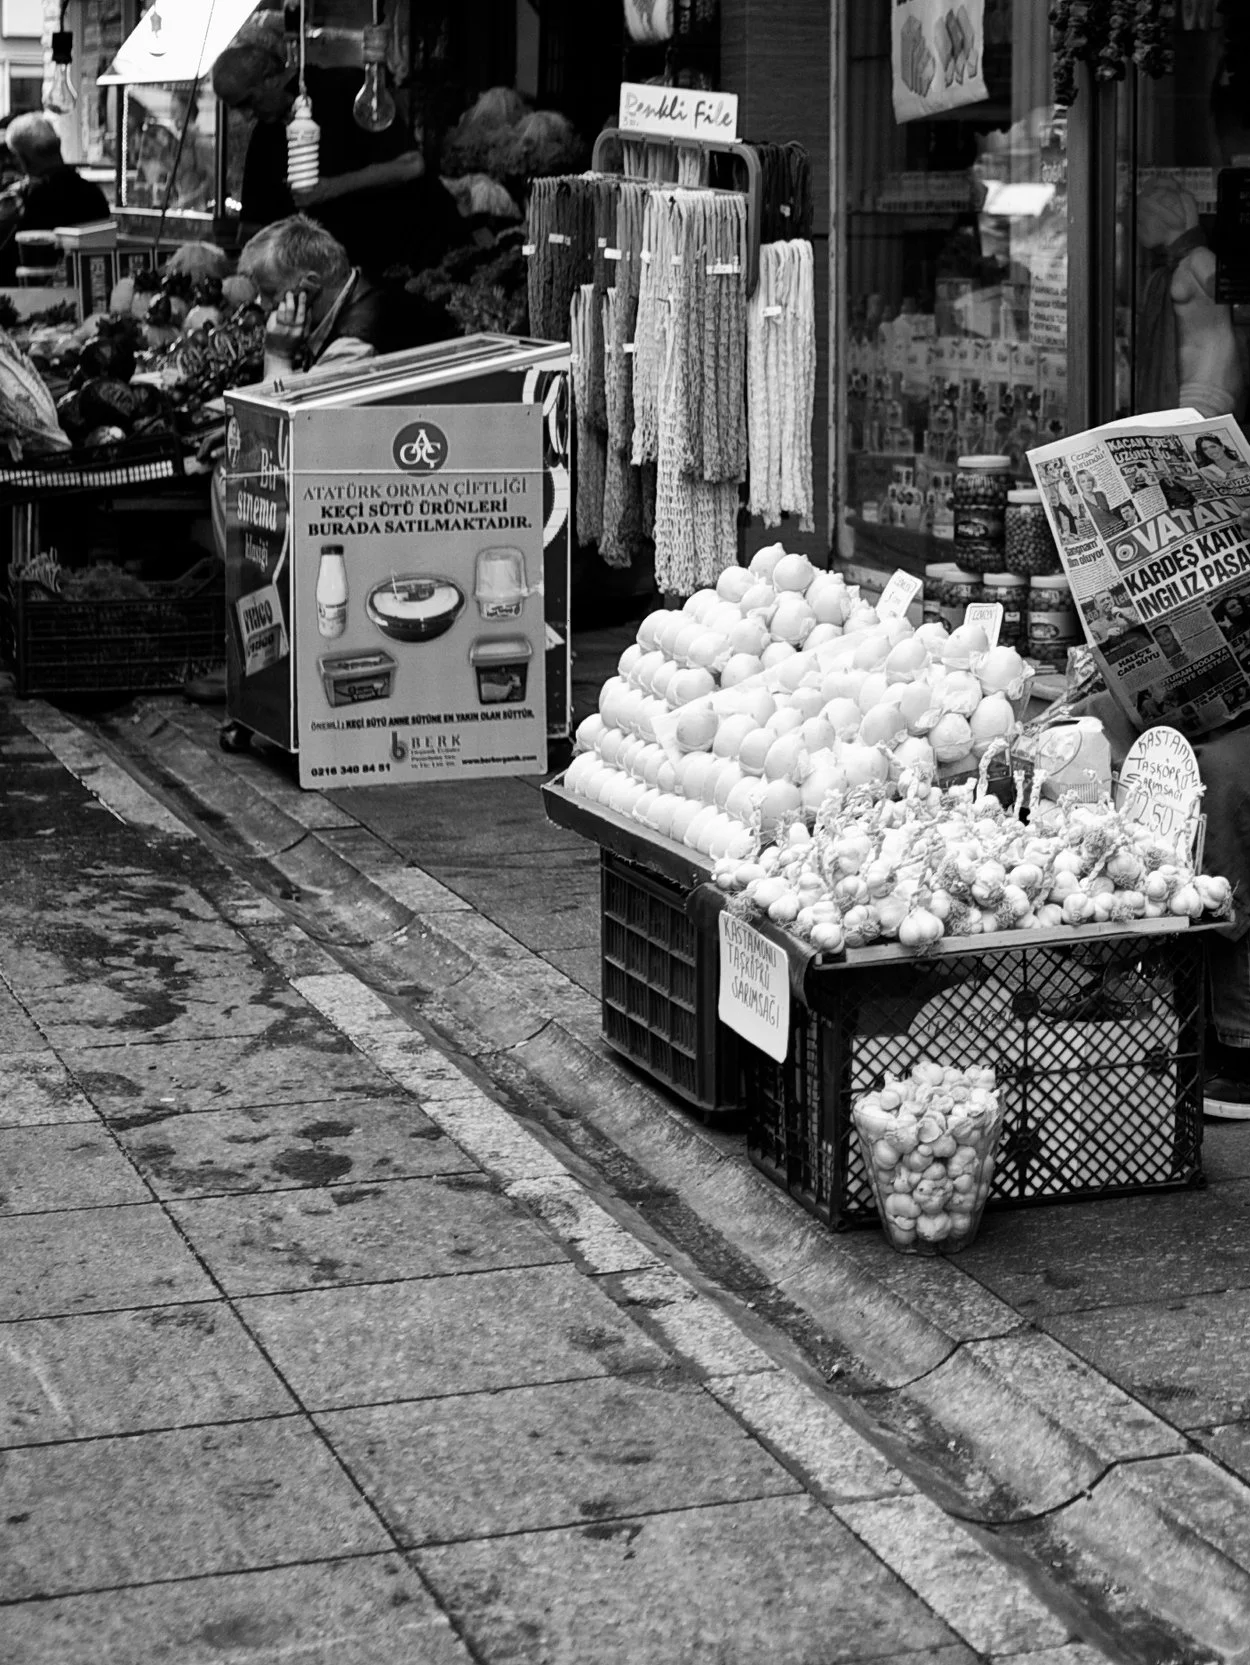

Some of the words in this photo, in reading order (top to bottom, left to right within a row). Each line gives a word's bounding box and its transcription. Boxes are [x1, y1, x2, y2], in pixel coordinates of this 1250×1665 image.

[624, 91, 688, 121] Renkli
[694, 99, 733, 129] File
[303, 482, 381, 500] ATATÜRK
[386, 482, 449, 498] ORMAN
[454, 477, 527, 497] ÇİFTLİĞİ
[321, 501, 364, 521] KEÇİ
[369, 500, 414, 518] SÜTÜ
[419, 497, 508, 517] ÜRÜNLERİ
[308, 520, 381, 536] BURADA
[384, 515, 532, 535] SATILMAKTADIR.
[1131, 497, 1242, 554] VATAN
[1123, 541, 1201, 598] KARDEŞ
[723, 917, 777, 968] KASTAMONU
[727, 942, 770, 990] TAŞKÖPRÜ
[732, 975, 780, 1028] SARIMSAĞI
